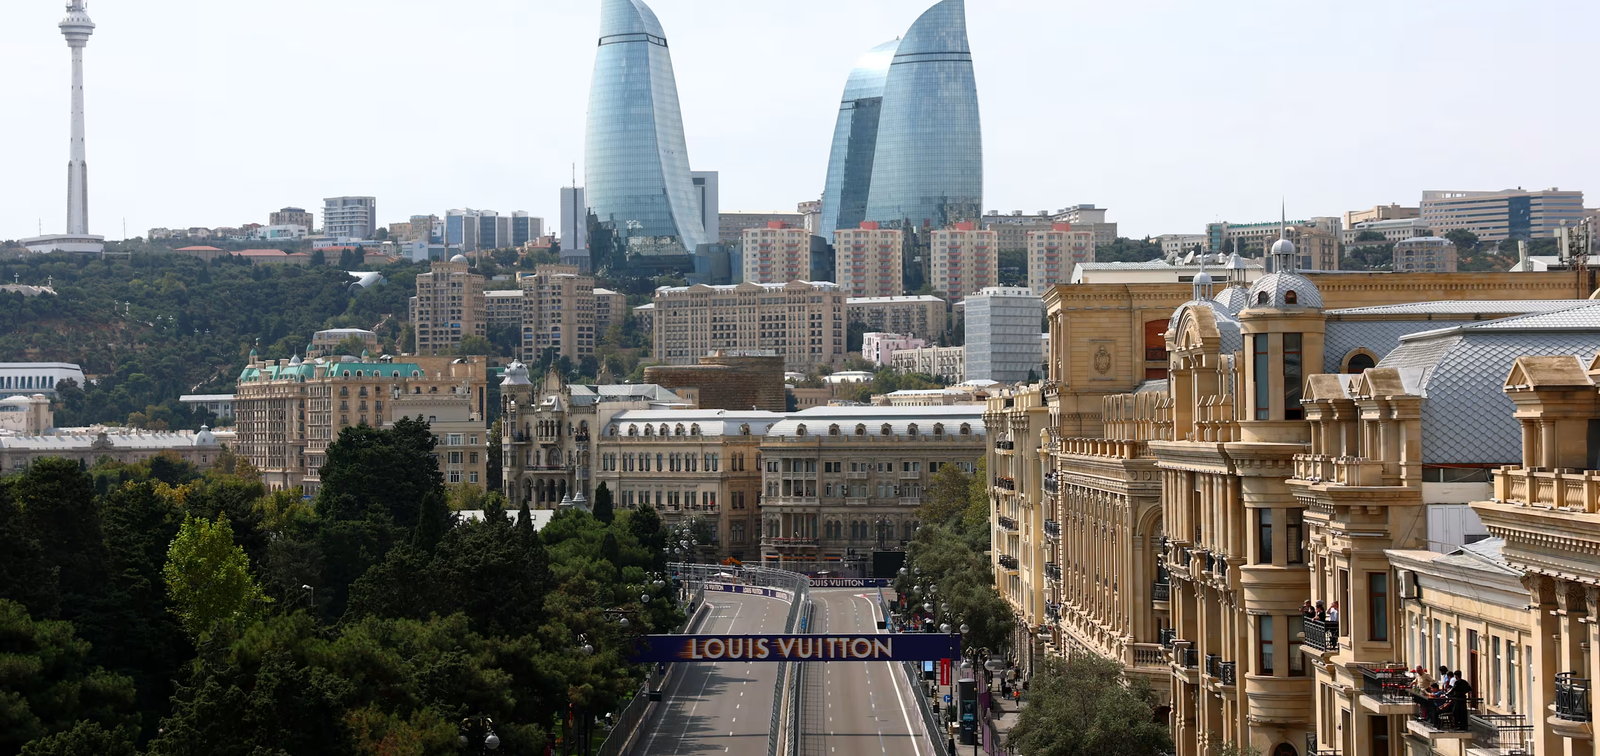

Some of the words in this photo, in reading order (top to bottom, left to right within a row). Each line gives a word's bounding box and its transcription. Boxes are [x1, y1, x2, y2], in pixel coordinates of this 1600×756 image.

[809, 579, 828, 587] OUIS
[830, 579, 864, 587] VUITTON
[692, 638, 770, 659] LOUIS
[779, 638, 893, 659] VUITTON
